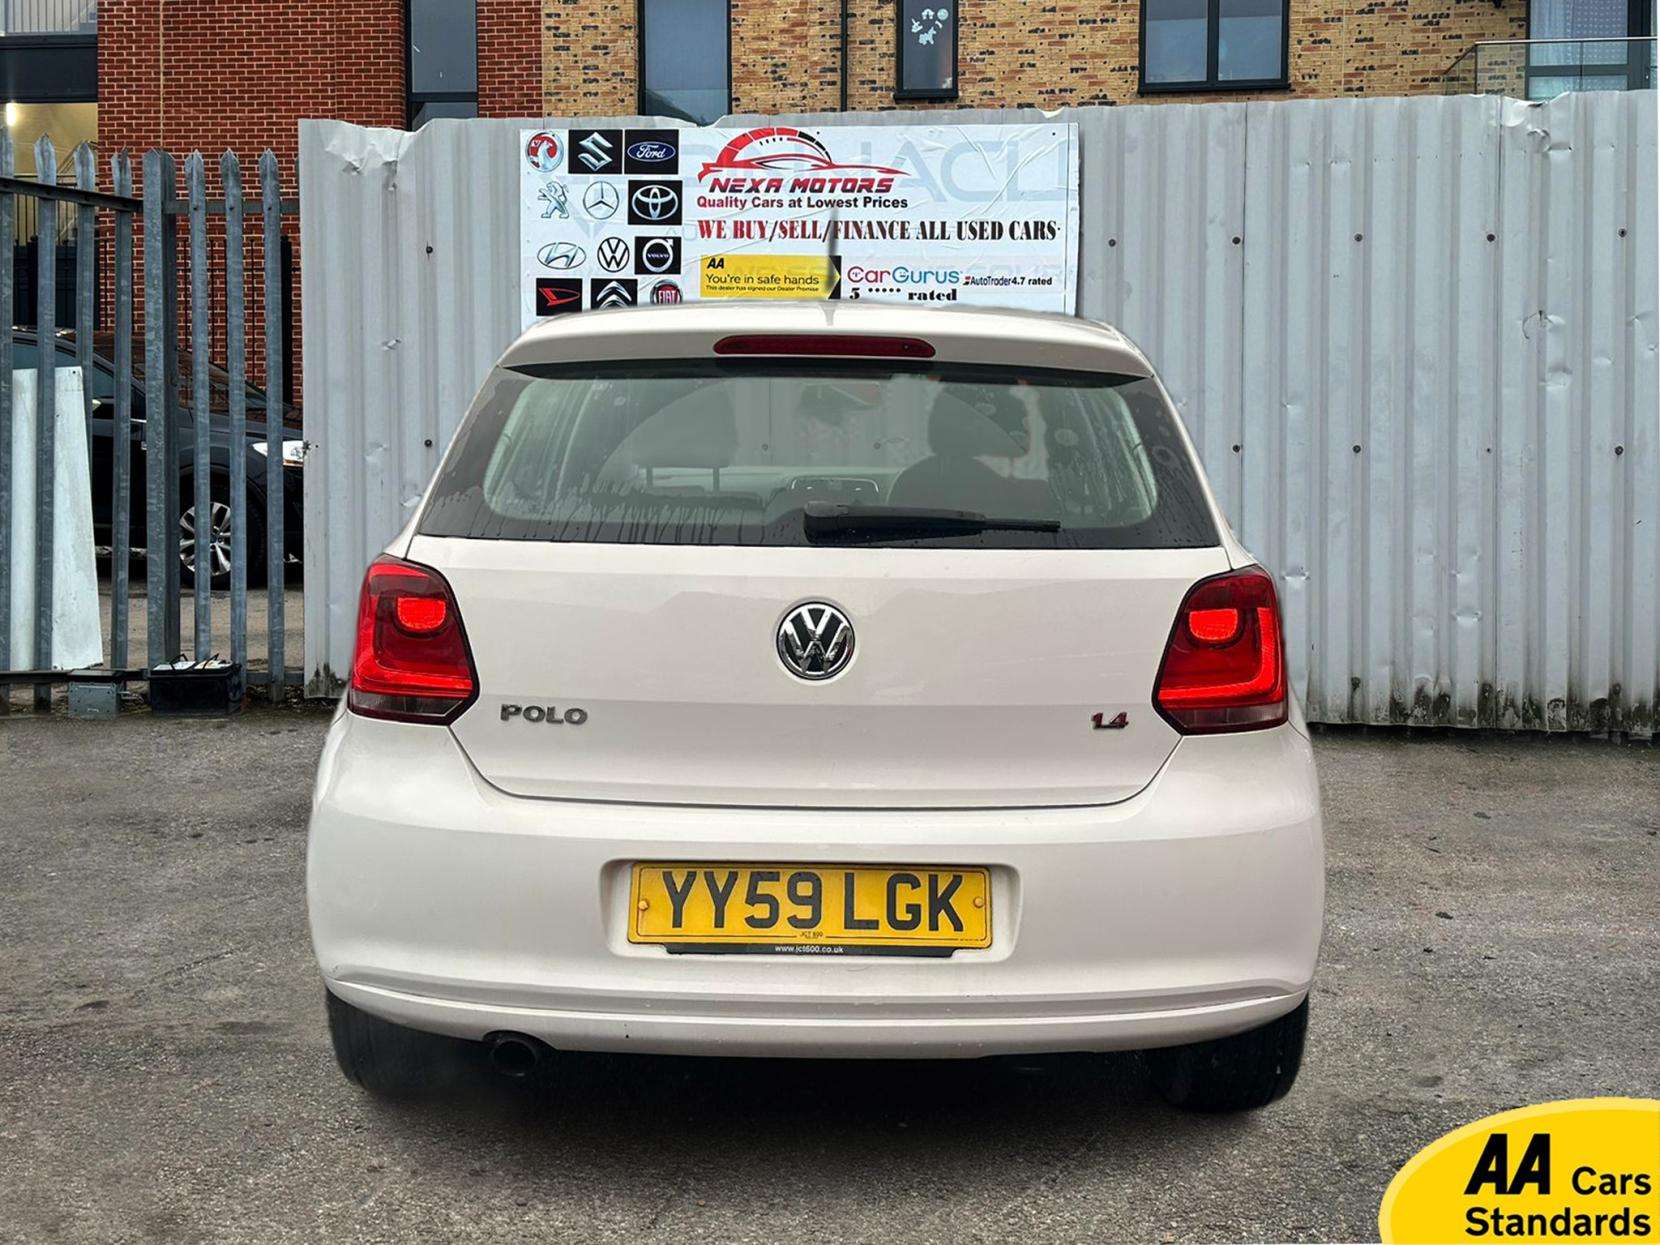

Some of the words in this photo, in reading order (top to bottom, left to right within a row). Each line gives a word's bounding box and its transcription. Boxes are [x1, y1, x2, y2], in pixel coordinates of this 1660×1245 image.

[637, 144, 666, 158] Ford
[709, 178, 783, 193] NEXA
[789, 178, 894, 194] MOTORS
[697, 196, 746, 209] Quality
[751, 196, 784, 208] Cars
[788, 196, 803, 208] at
[807, 197, 858, 208] Lowest
[863, 197, 908, 208] Prices
[697, 220, 727, 239] WE
[732, 220, 911, 242] BUY/SELL/FINANCE
[917, 221, 951, 240] ALL
[957, 221, 1003, 241] USED
[1009, 221, 1057, 240] CARS
[707, 257, 725, 269] AA
[706, 273, 741, 284] You're
[744, 274, 754, 284] in
[757, 274, 781, 284] safe
[784, 275, 819, 285] hands
[848, 266, 960, 284] CarGurus
[1011, 276, 1025, 285] 4.7
[1028, 277, 1052, 285] rated
[658, 290, 676, 304] FIAT
[850, 288, 860, 300] 5
[908, 289, 957, 301] rated
[500, 704, 588, 725] POLO
[1092, 712, 1129, 729] 1.4
[662, 870, 823, 930] YY59
[843, 873, 964, 932] LGK
